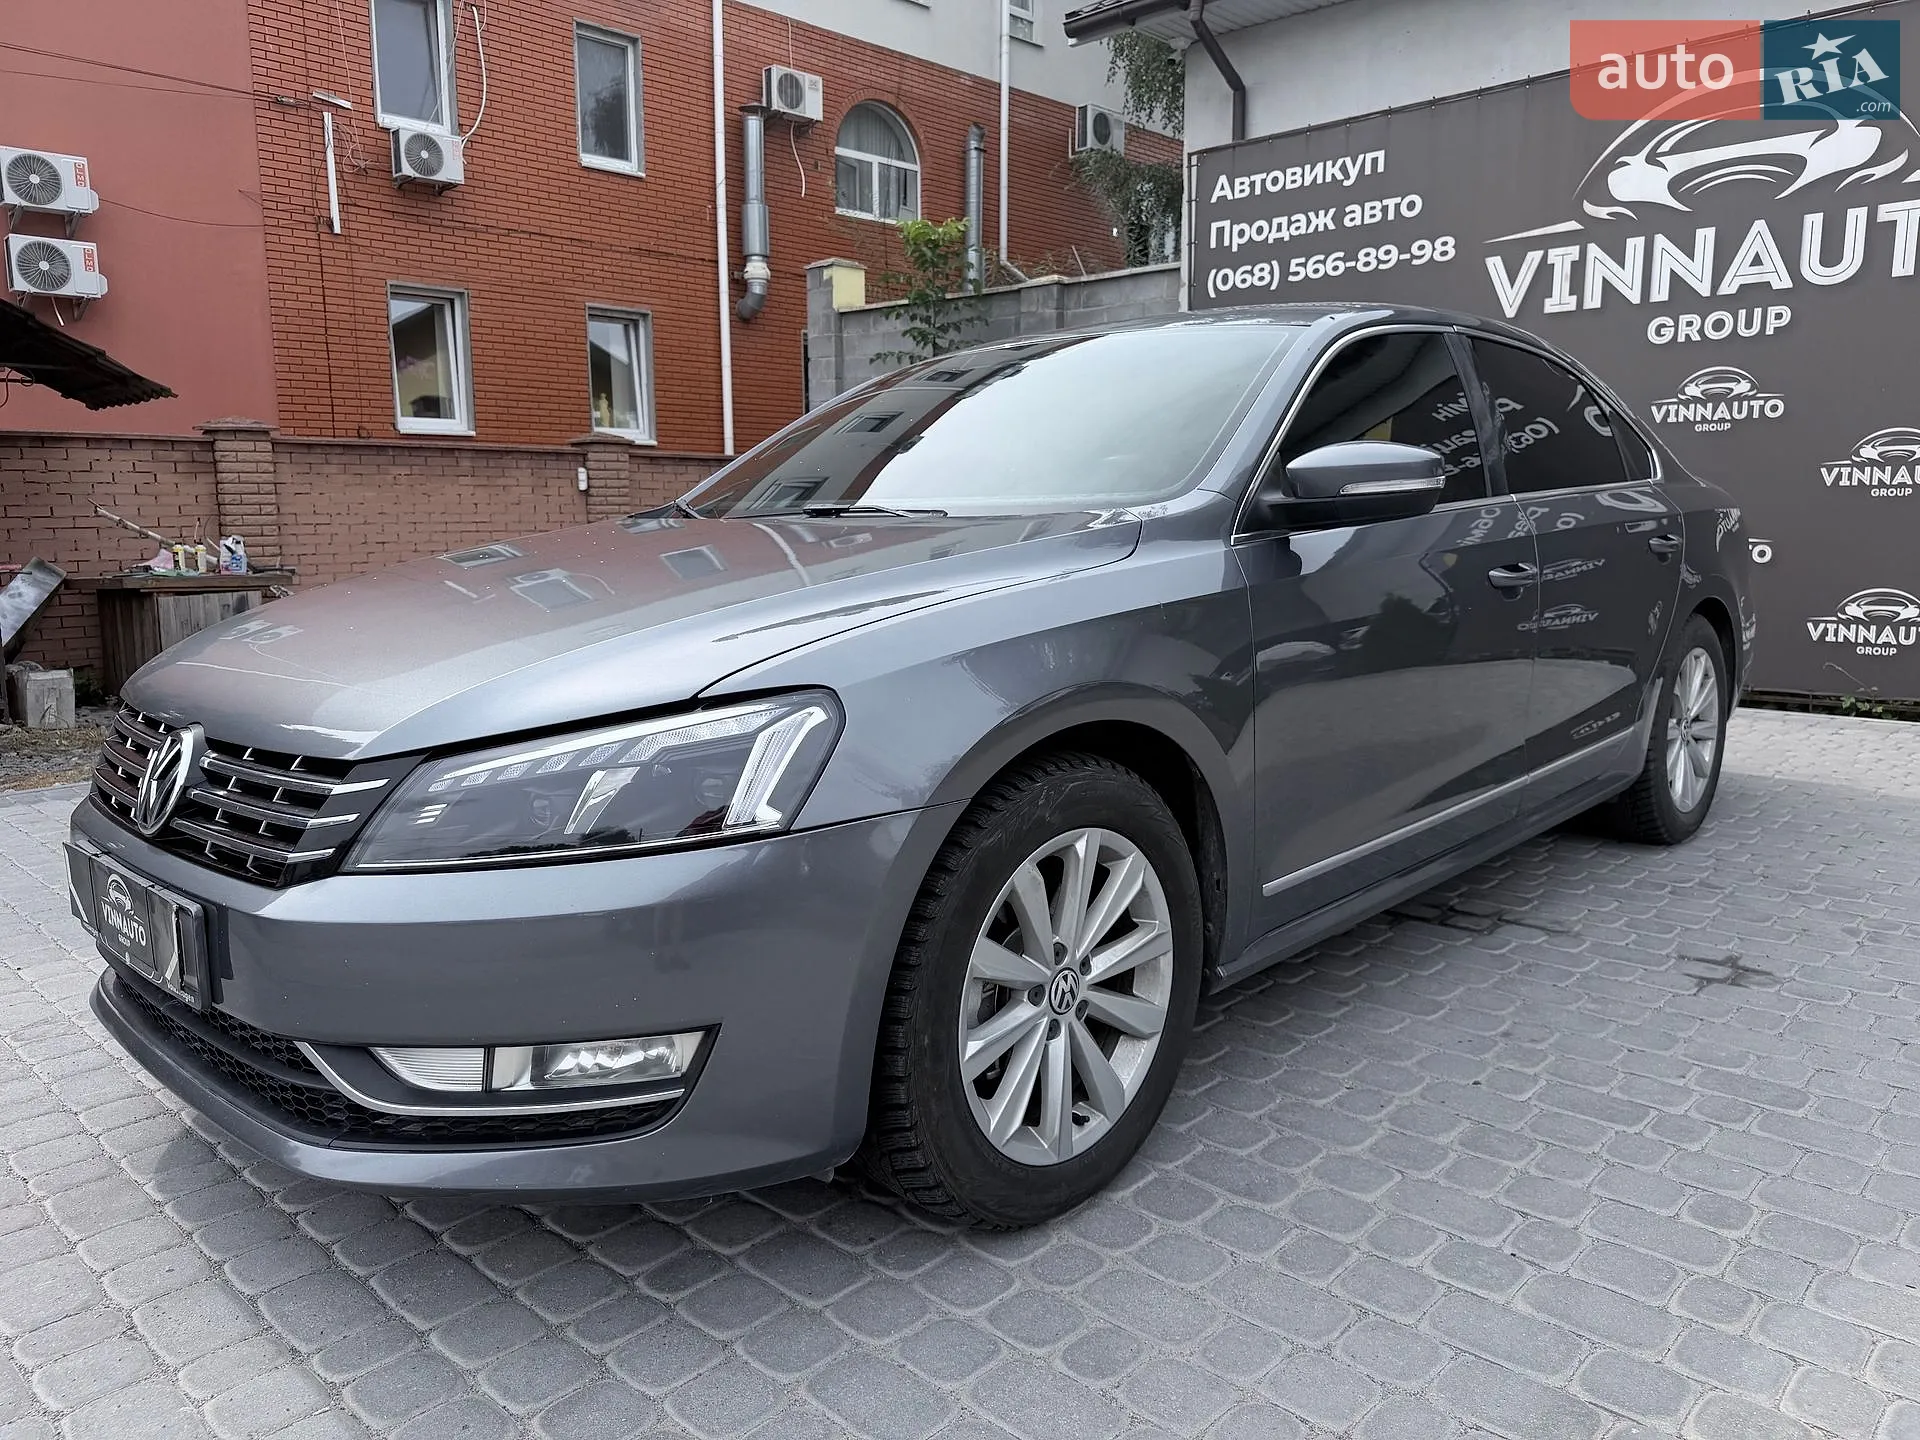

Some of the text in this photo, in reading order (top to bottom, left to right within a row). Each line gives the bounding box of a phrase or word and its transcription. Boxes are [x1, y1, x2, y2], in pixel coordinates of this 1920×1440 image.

[1210, 149, 1386, 203] Автовикуп
[1209, 193, 1424, 253] Продаж авто
[1207, 235, 1456, 298] (068) 566-89-98
[1646, 305, 1793, 345] GROUP
[1650, 398, 1785, 424] VINNAUTO
[1694, 421, 1732, 433] GROUP
[1870, 487, 1913, 497] GROUP
[1806, 621, 1920, 646] VINNAU
[1856, 646, 1897, 656] GROUP
[101, 900, 147, 947] VINNAUTO
